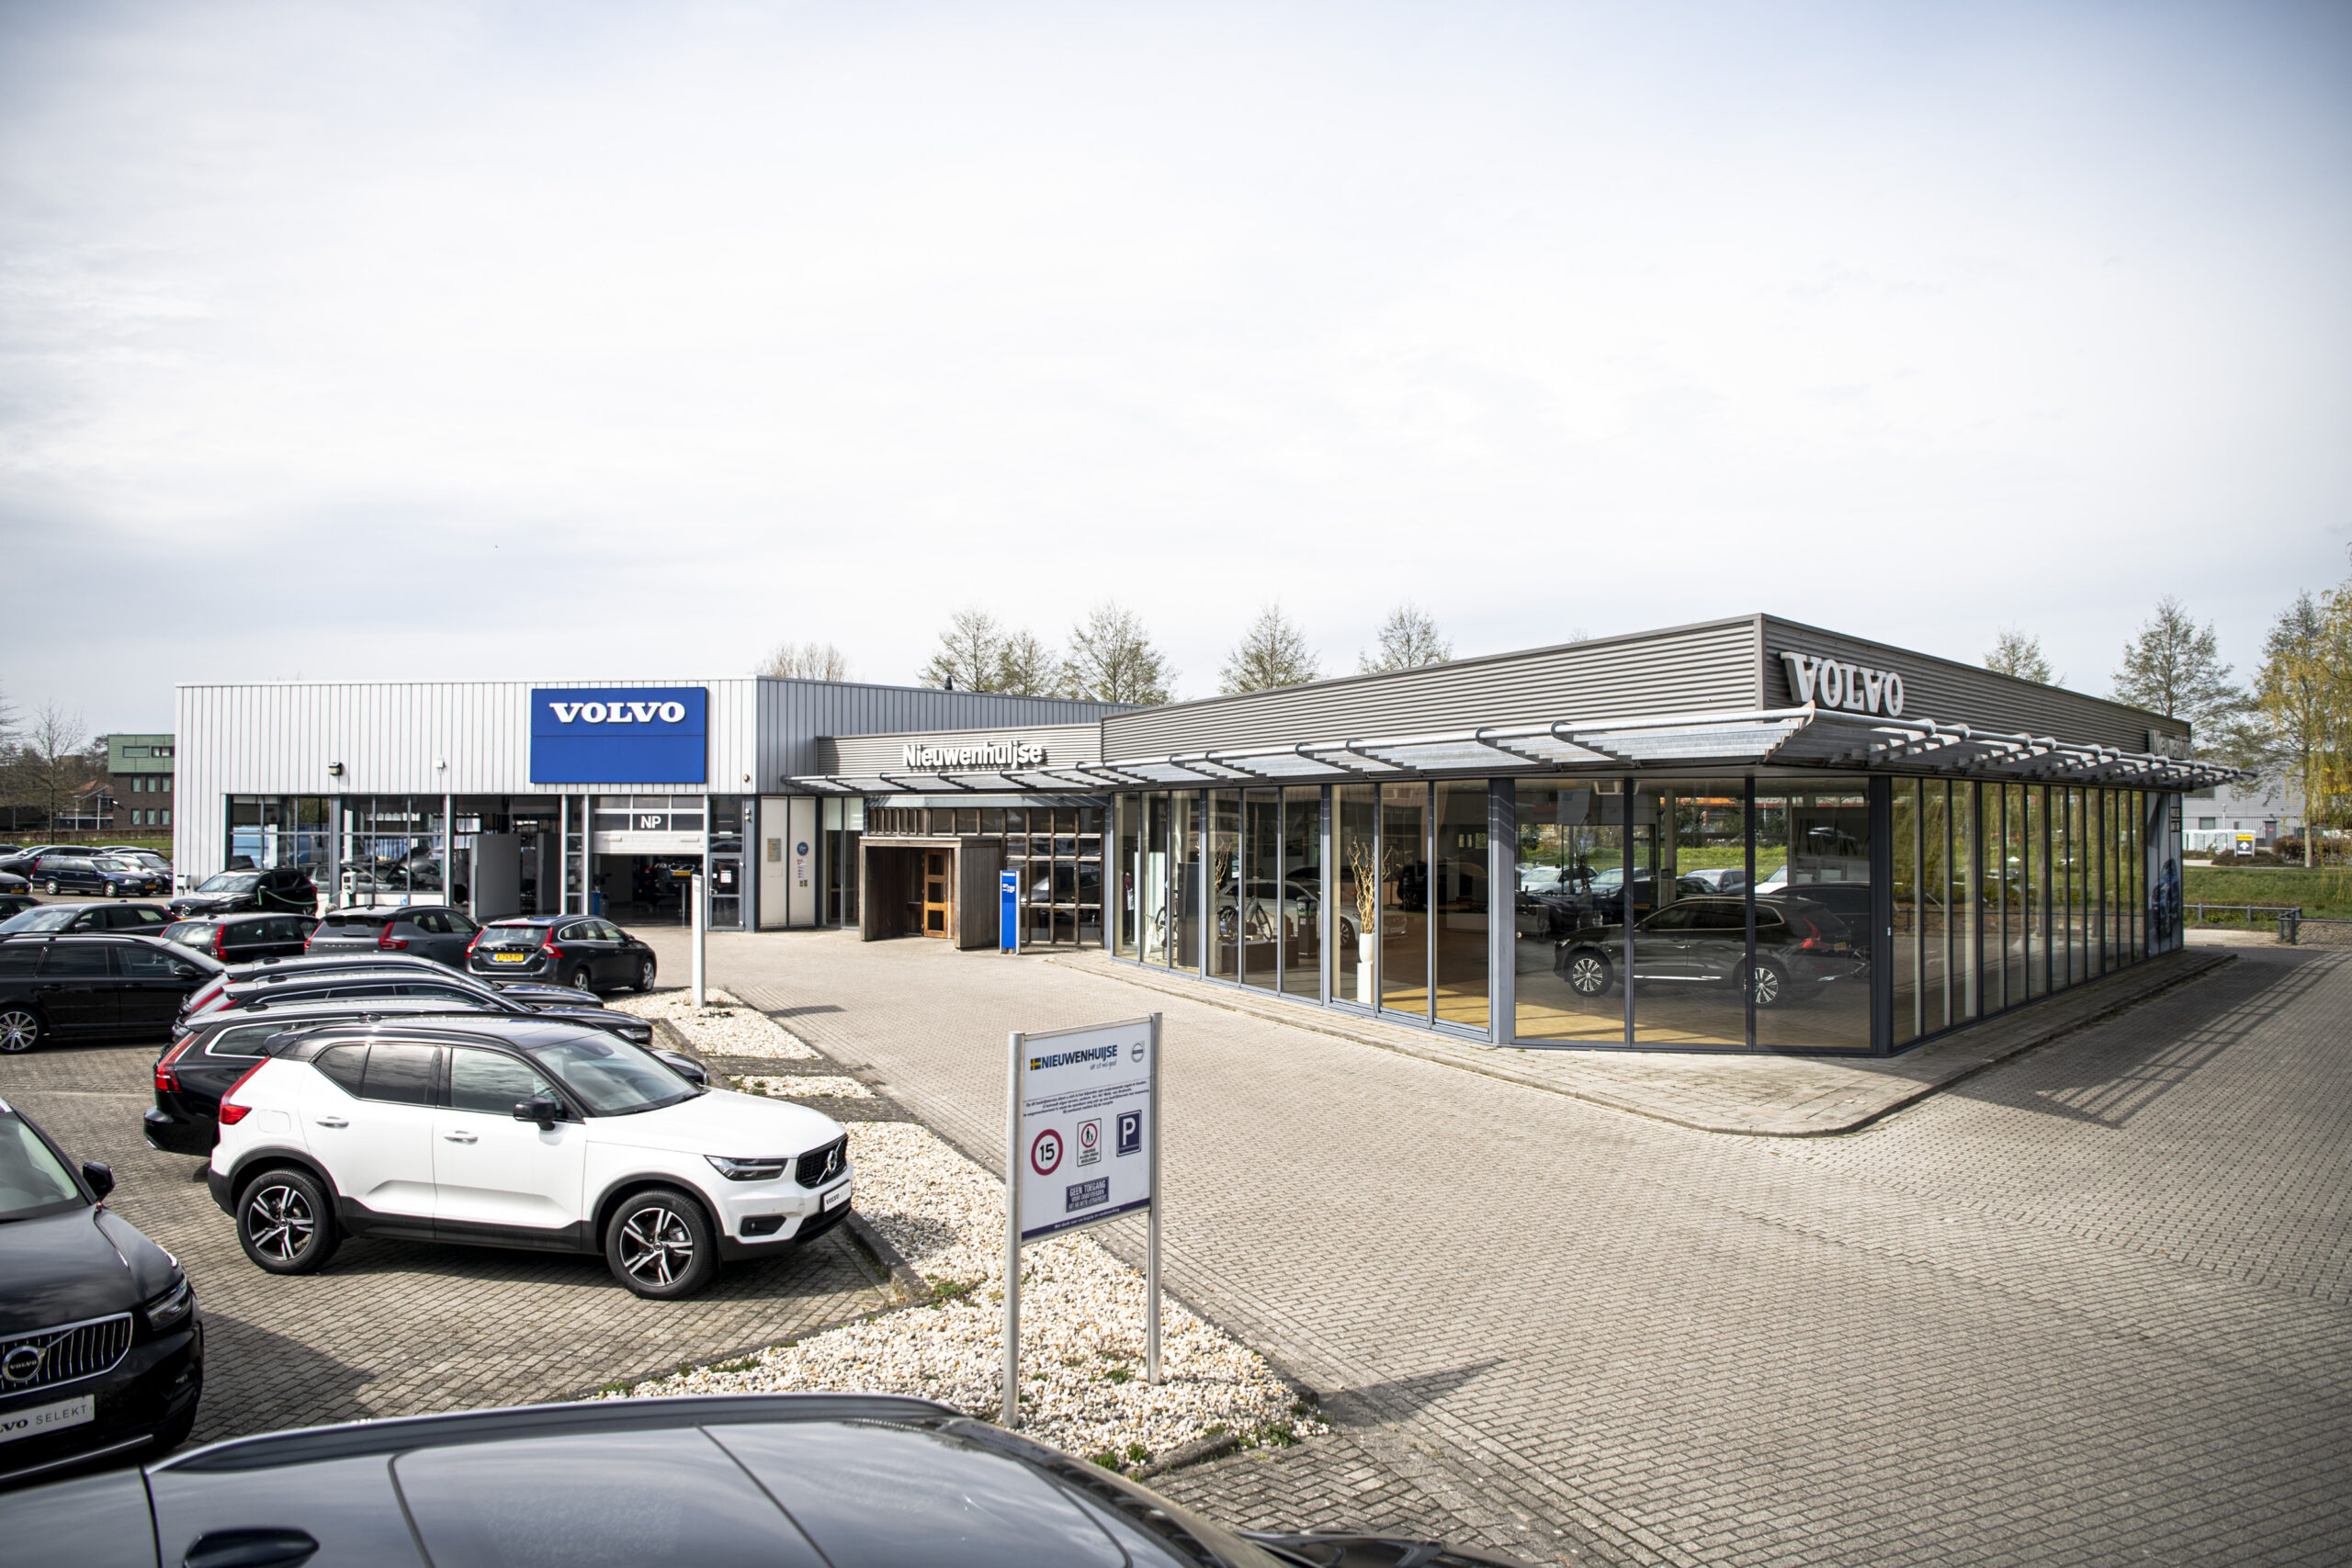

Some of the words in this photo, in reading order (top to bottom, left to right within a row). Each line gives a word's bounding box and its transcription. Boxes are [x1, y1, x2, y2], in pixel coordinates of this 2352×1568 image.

[1781, 651, 1904, 716] VOLVO
[549, 702, 685, 723] VOLVO
[902, 741, 1044, 770] Nieuwenhuijse
[640, 815, 662, 829] NP
[1041, 1044, 1118, 1069] NIEUWENHUIJSE
[1123, 1117, 1136, 1146] P
[1039, 1143, 1055, 1162] 15
[1069, 1186, 1083, 1197] GEEN
[1084, 1179, 1106, 1193] TOEGANG
[9, 1359, 38, 1371] VOLVO
[36, 1404, 87, 1425] SELEKT
